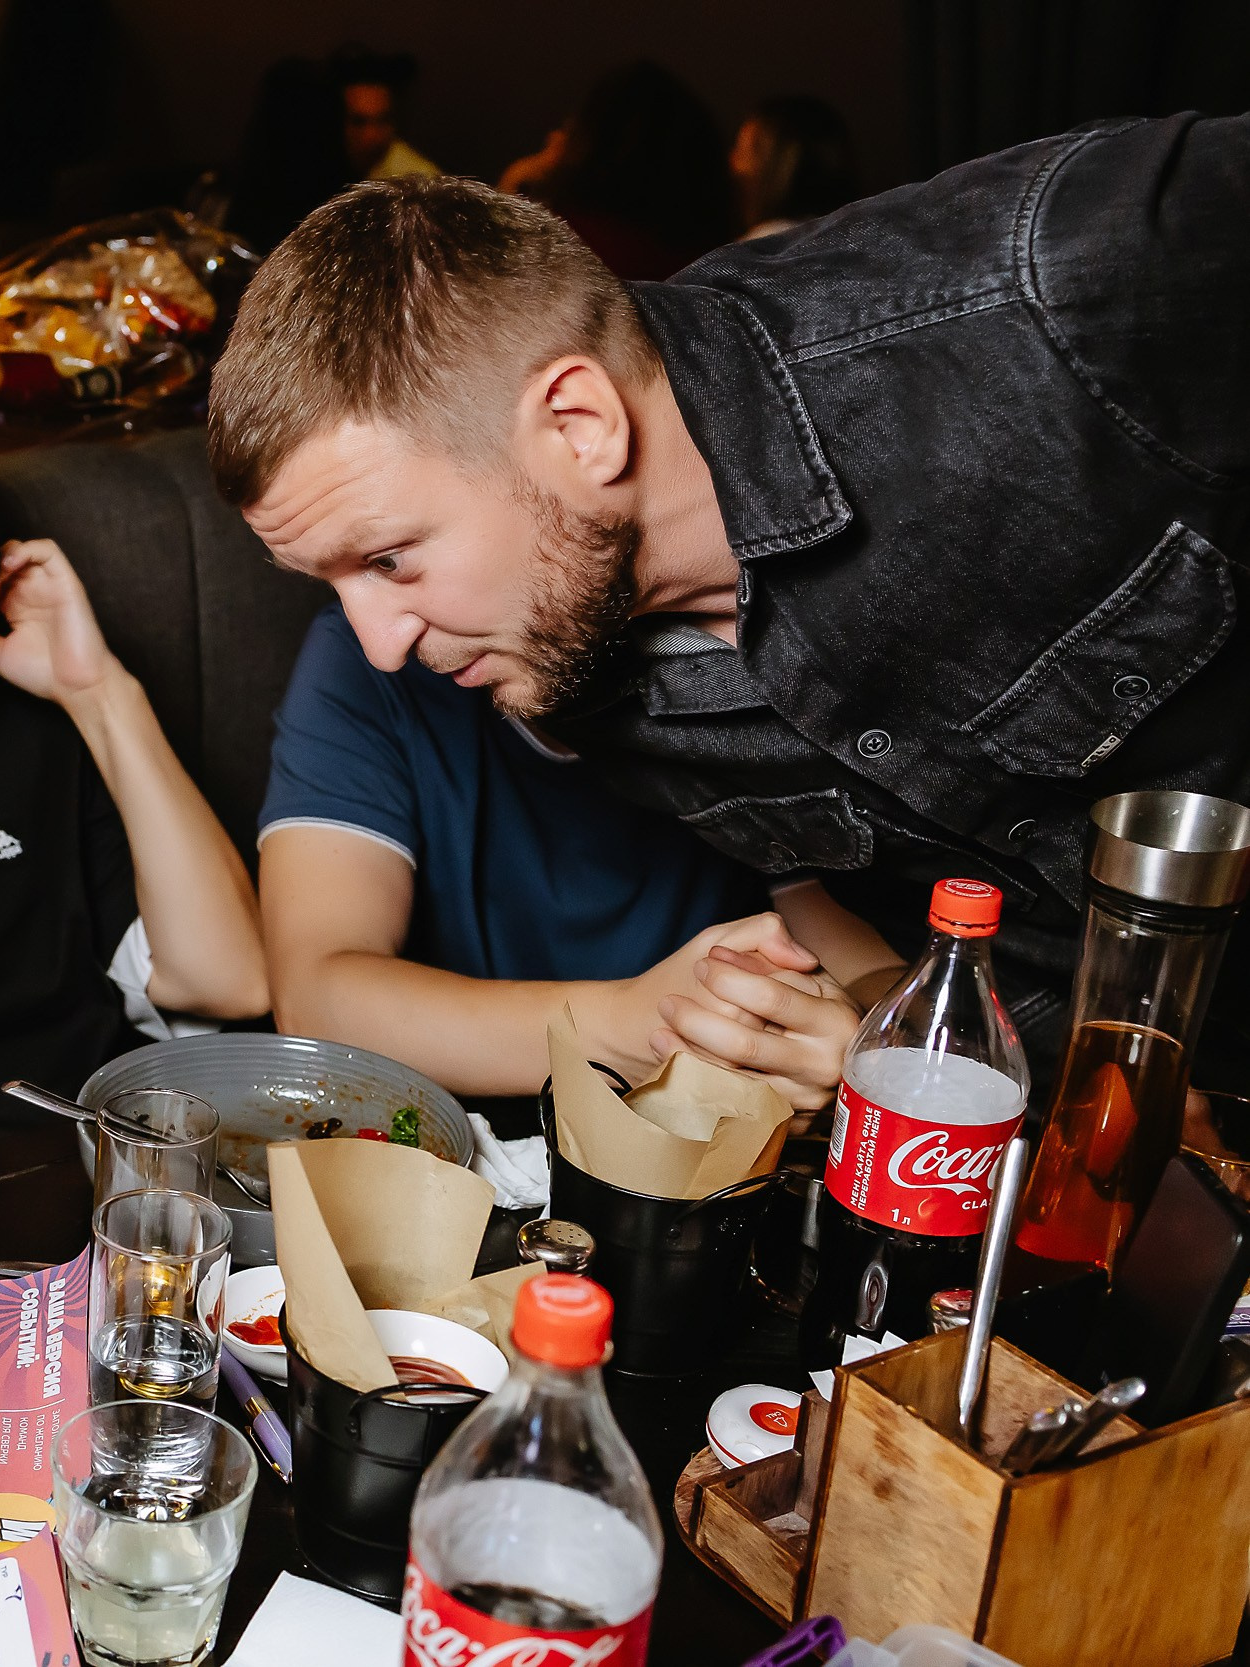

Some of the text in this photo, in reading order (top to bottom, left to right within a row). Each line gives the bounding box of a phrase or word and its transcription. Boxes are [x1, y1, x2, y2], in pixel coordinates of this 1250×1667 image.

[855, 1141, 868, 1177] ҚАЙТА
[858, 1110, 882, 1210] ПЕРЕРАБОТАЙ МЕНЯ
[850, 1180, 861, 1206] МЕНІ
[961, 1199, 991, 1210] CLA
[891, 1208, 900, 1222] 1
[16, 1288, 40, 1369] СОБЫТИЙ:
[43, 1278, 66, 1399] ВАША ВЕРСИЯ
[0, 1417, 12, 1465] ДЛЯ СВЕРКИ
[16, 1417, 28, 1451] КОМАНД
[33, 1414, 45, 1471] ПО ЖЕЛАНИЮ
[1, 1566, 9, 1578] ТУР
[4, 1584, 23, 1601] 7
